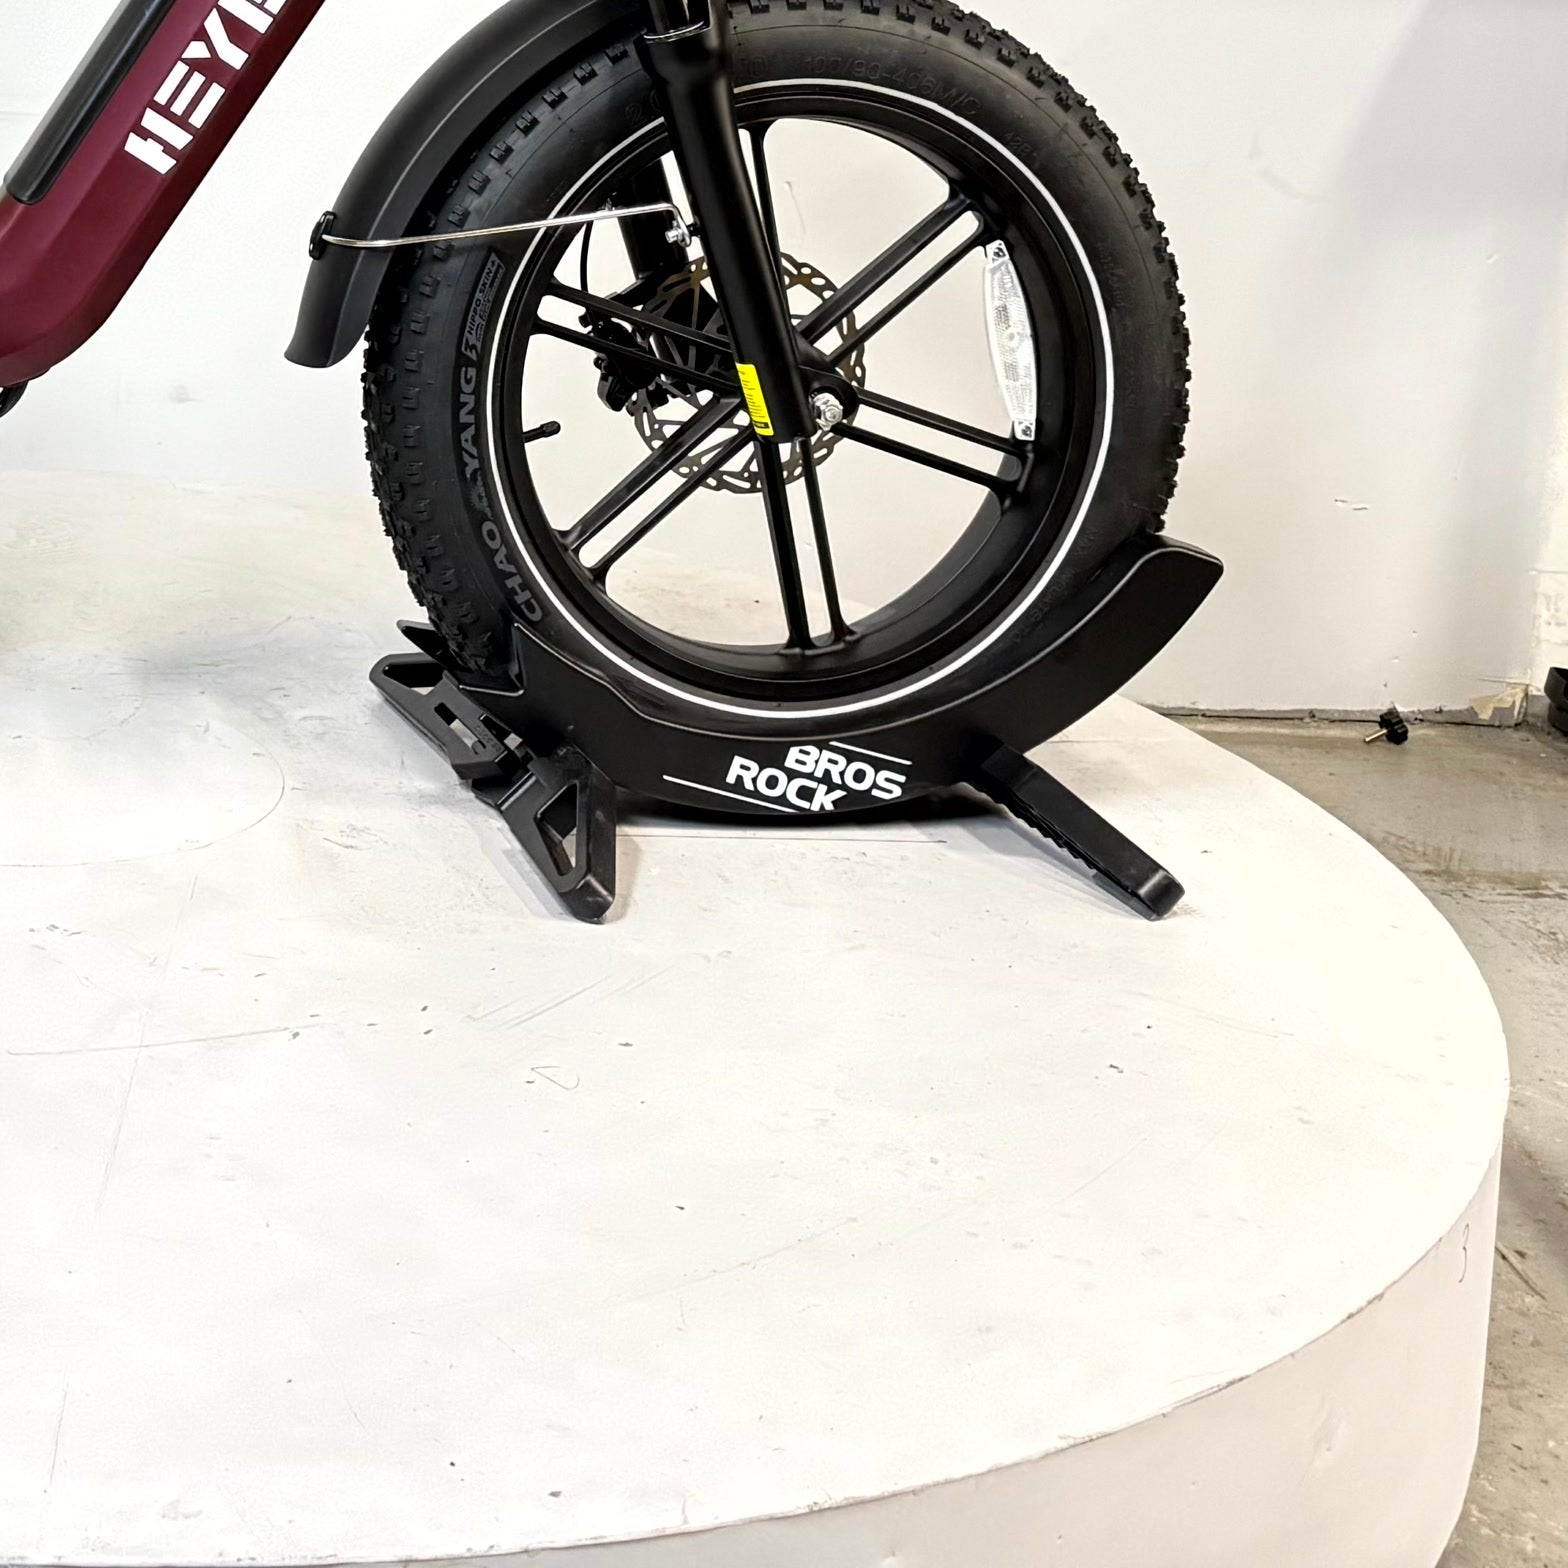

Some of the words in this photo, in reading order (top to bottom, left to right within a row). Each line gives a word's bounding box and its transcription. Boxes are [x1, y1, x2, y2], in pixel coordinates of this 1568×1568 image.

[458, 365, 481, 481] YANG
[481, 519, 543, 623] CHAO
[725, 754, 848, 812] ROCK
[783, 744, 907, 800] BROS
